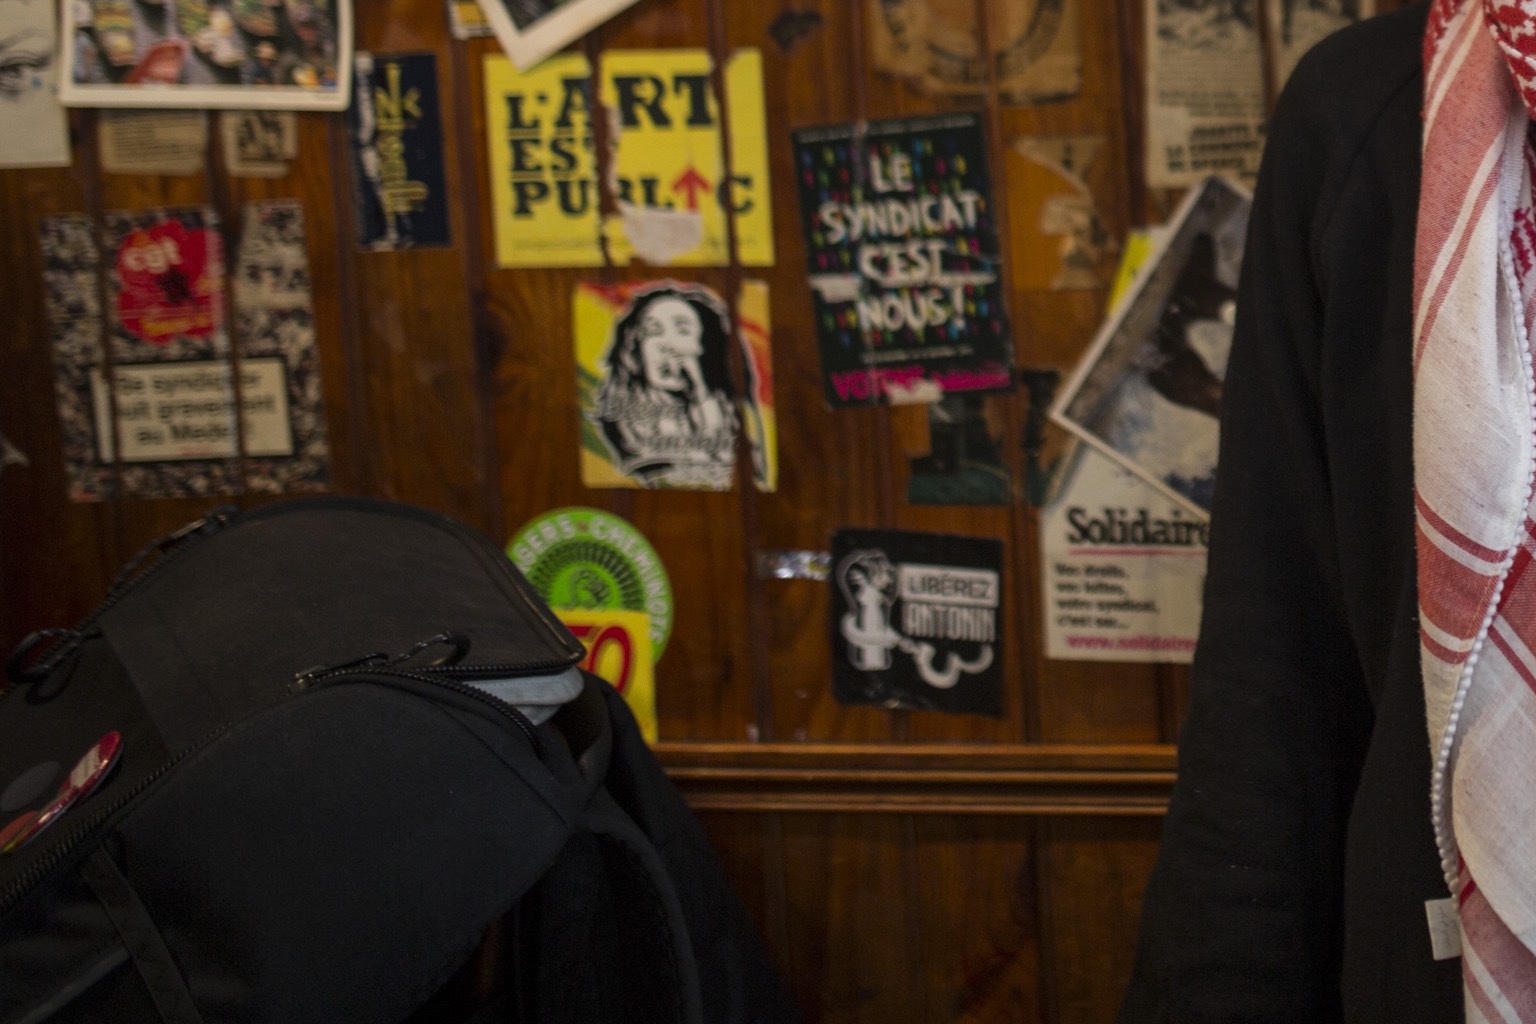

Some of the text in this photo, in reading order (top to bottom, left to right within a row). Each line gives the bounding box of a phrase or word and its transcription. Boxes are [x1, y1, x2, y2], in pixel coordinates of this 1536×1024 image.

[868, 151, 912, 192] LE
[818, 188, 977, 244] SYNDICAT
[123, 237, 183, 273] cgt
[908, 576, 993, 599] LIBÉREZ
[906, 604, 996, 642] ANTONIN
